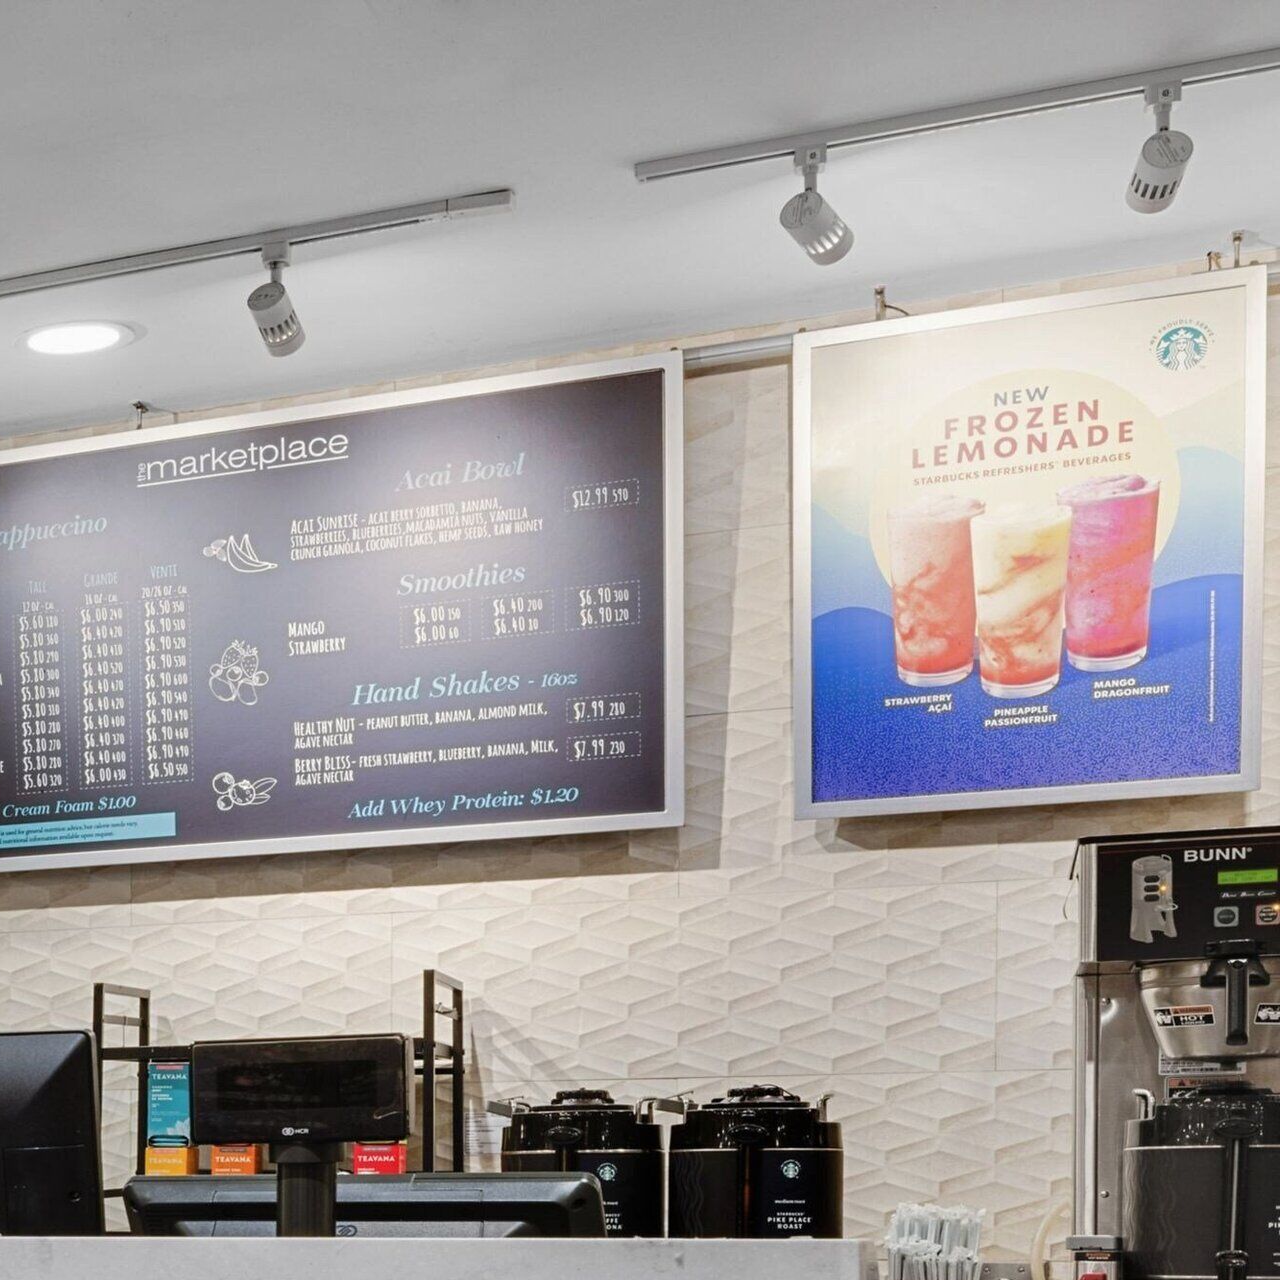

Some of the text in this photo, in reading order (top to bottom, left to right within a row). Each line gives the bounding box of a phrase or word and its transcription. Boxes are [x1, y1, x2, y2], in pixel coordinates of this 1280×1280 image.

[994, 386, 1049, 407] NEW
[945, 399, 1099, 440] FROZEN
[912, 421, 1134, 468] LEMONADE
[137, 434, 348, 482] the marketplace
[394, 453, 526, 492] Acai Bowl
[913, 470, 980, 486] STARBUCKS
[1063, 452, 1131, 468] BEVERAGES
[572, 487, 608, 508] $12.99
[396, 563, 526, 597] Smoothies
[288, 621, 325, 638] MANGO
[288, 636, 346, 656] STRAWBERRY
[352, 677, 420, 706] Hand
[428, 670, 520, 698] Shakes
[1093, 684, 1170, 699] DRAGONFRUIT
[1094, 678, 1136, 689] MANGO
[573, 700, 605, 720] $7.99
[884, 693, 952, 707] STRAWBERRY
[294, 719, 334, 736] HEALTHY
[335, 717, 355, 733] NUT
[478, 705, 517, 721] ALMOND
[994, 705, 1048, 716] PINEAPPLE
[984, 714, 1058, 728] PASSIONFRUIT
[294, 733, 353, 750] AGAVE NECTAR
[574, 740, 605, 759] $7.99
[295, 757, 322, 774] BERRY
[2, 804, 50, 818] Cream
[55, 800, 94, 814] Foam
[98, 795, 137, 811] $1.00
[348, 787, 579, 819] Add Whey Protein: $1.20
[1184, 847, 1247, 863] BUNN
[1179, 1015, 1205, 1023] HOT
[215, 1155, 251, 1163] TEAVANA
